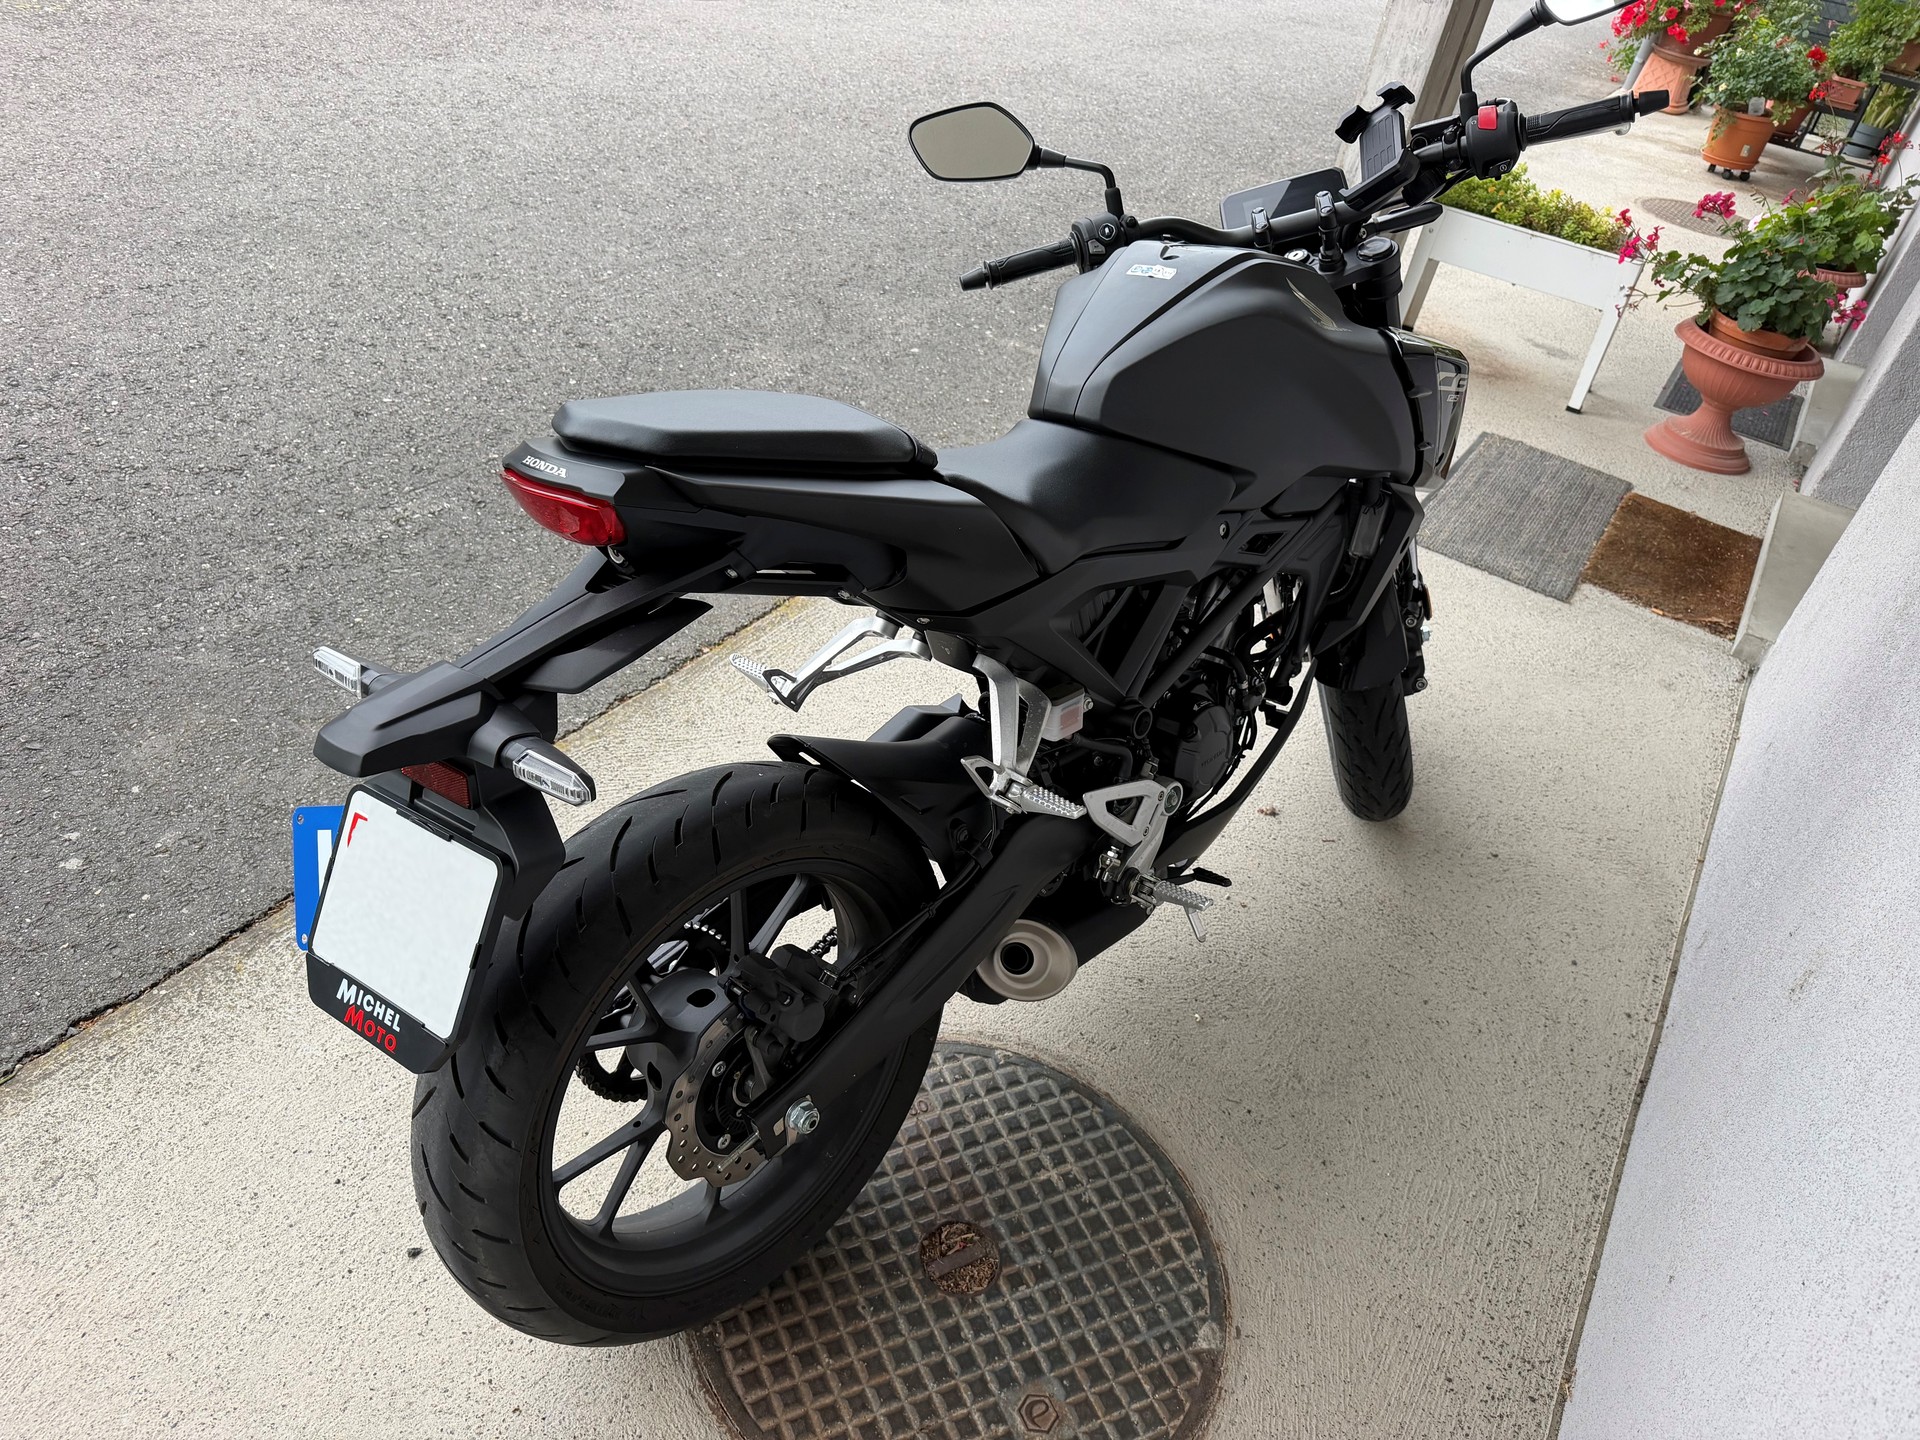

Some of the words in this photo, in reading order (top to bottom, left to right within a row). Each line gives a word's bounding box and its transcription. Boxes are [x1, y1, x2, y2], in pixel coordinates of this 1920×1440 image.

[522, 455, 567, 479] HONDA
[336, 977, 402, 1033] MICHEL
[344, 1004, 398, 1054] MOTO
